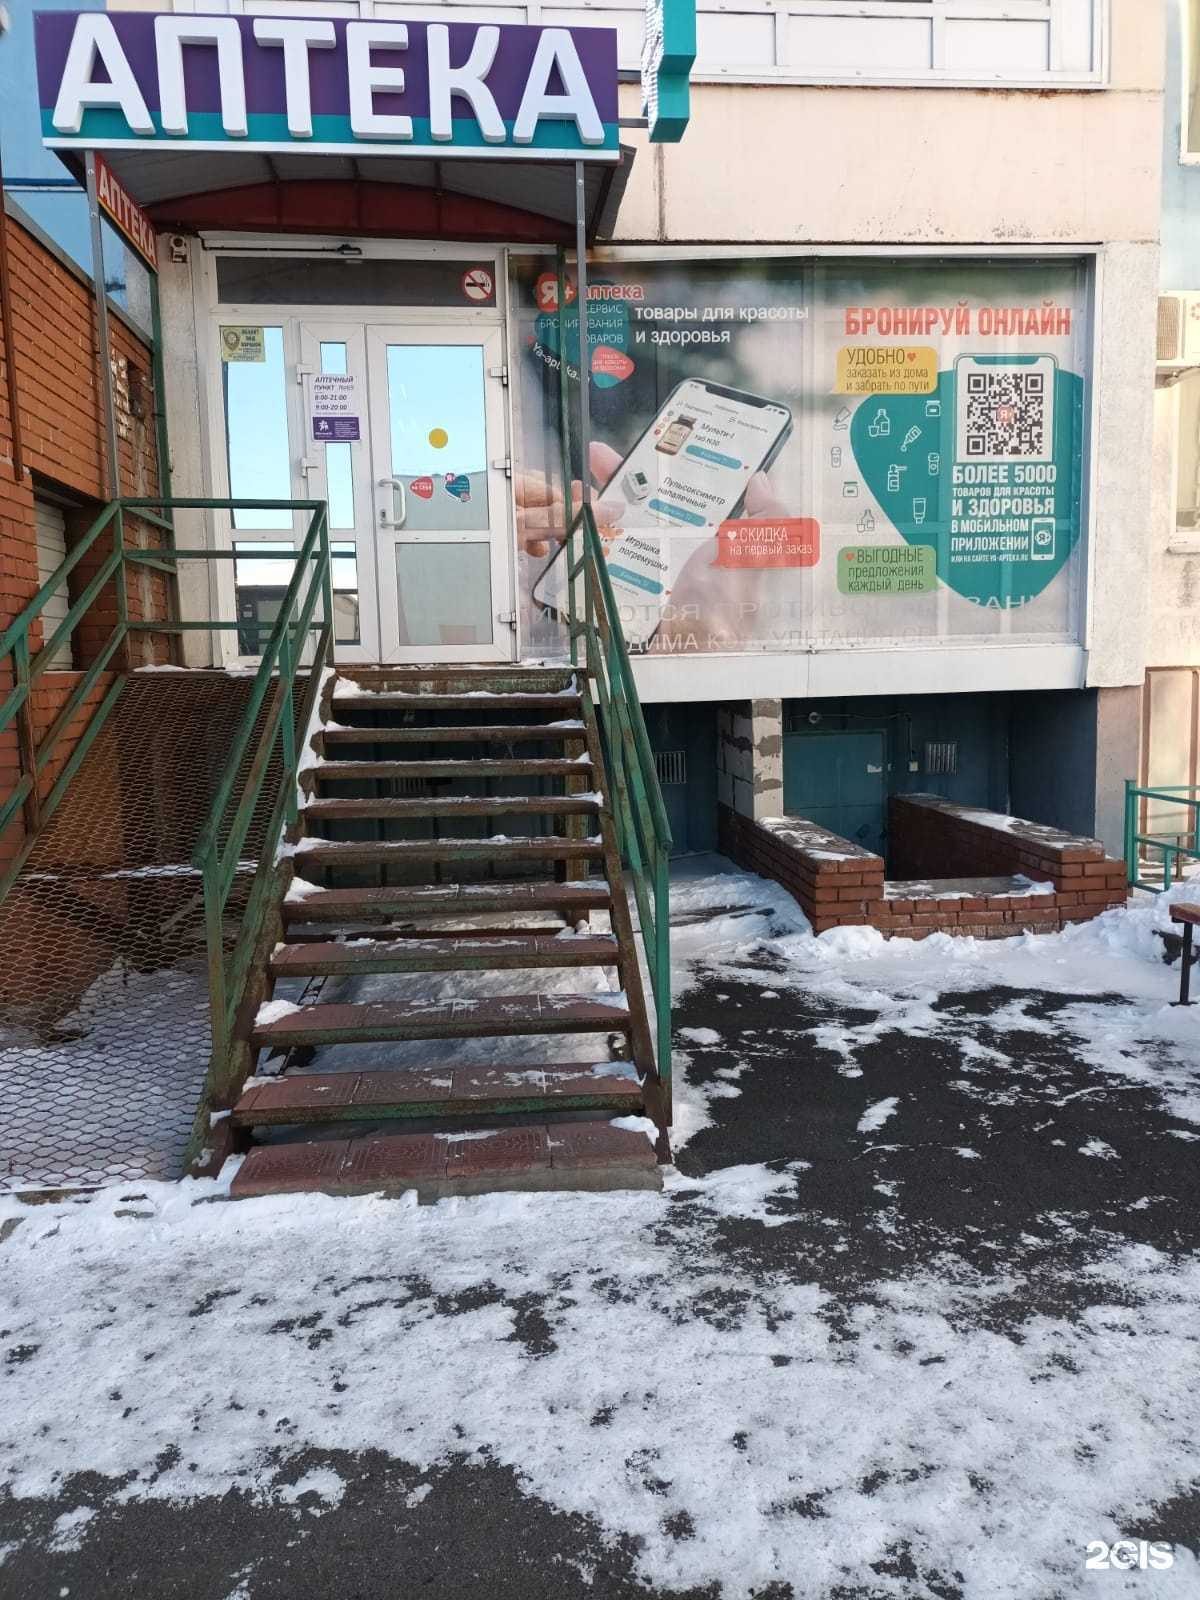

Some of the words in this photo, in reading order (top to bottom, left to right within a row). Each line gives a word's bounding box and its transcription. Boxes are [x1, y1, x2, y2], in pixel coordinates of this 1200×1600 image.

[52, 13, 605, 144] АПТЕКА
[100, 164, 157, 266] АПТЕКА
[585, 284, 643, 301] птека
[635, 307, 697, 322] товары
[702, 307, 734, 322] для
[739, 307, 809, 322] красоты
[845, 301, 971, 336] БРОНИРУЙ
[978, 301, 1072, 336] ОНЛАЙН
[635, 330, 646, 343] и
[651, 330, 731, 346] здоровья
[847, 348, 905, 366] УДОБНО
[846, 369, 887, 378] заказать
[889, 369, 901, 378] из
[903, 369, 929, 378] дома
[846, 383, 853, 391] и
[855, 380, 892, 392] забрать
[894, 382, 906, 390] по
[908, 382, 931, 392] пути
[952, 465, 1008, 484] БОЛЕЕ
[1014, 465, 1057, 483] 5000
[663, 476, 726, 506] Пульсоксиметр
[952, 487, 991, 496] ТОВАРОВ
[993, 487, 1011, 497] ДЛЯ
[1013, 486, 1054, 495] КРАСОТЫ
[952, 499, 963, 516] И
[968, 498, 1055, 517] ЗДОРОВЬЯ
[951, 520, 958, 533] В
[960, 519, 1029, 533] МОБИЛЬНОМ
[740, 528, 788, 542] СКИДКА
[625, 535, 661, 555] Игрушка
[730, 546, 742, 554] на
[744, 543, 783, 555] первый
[785, 545, 813, 554] заказ
[951, 536, 1029, 551] ПРИЛОЖЕНИИ
[618, 546, 669, 572] погремушка
[857, 548, 924, 564] ВЫГОДНЫЕ
[848, 565, 924, 579] предложения
[848, 578, 891, 593] каждый
[897, 580, 924, 592] день
